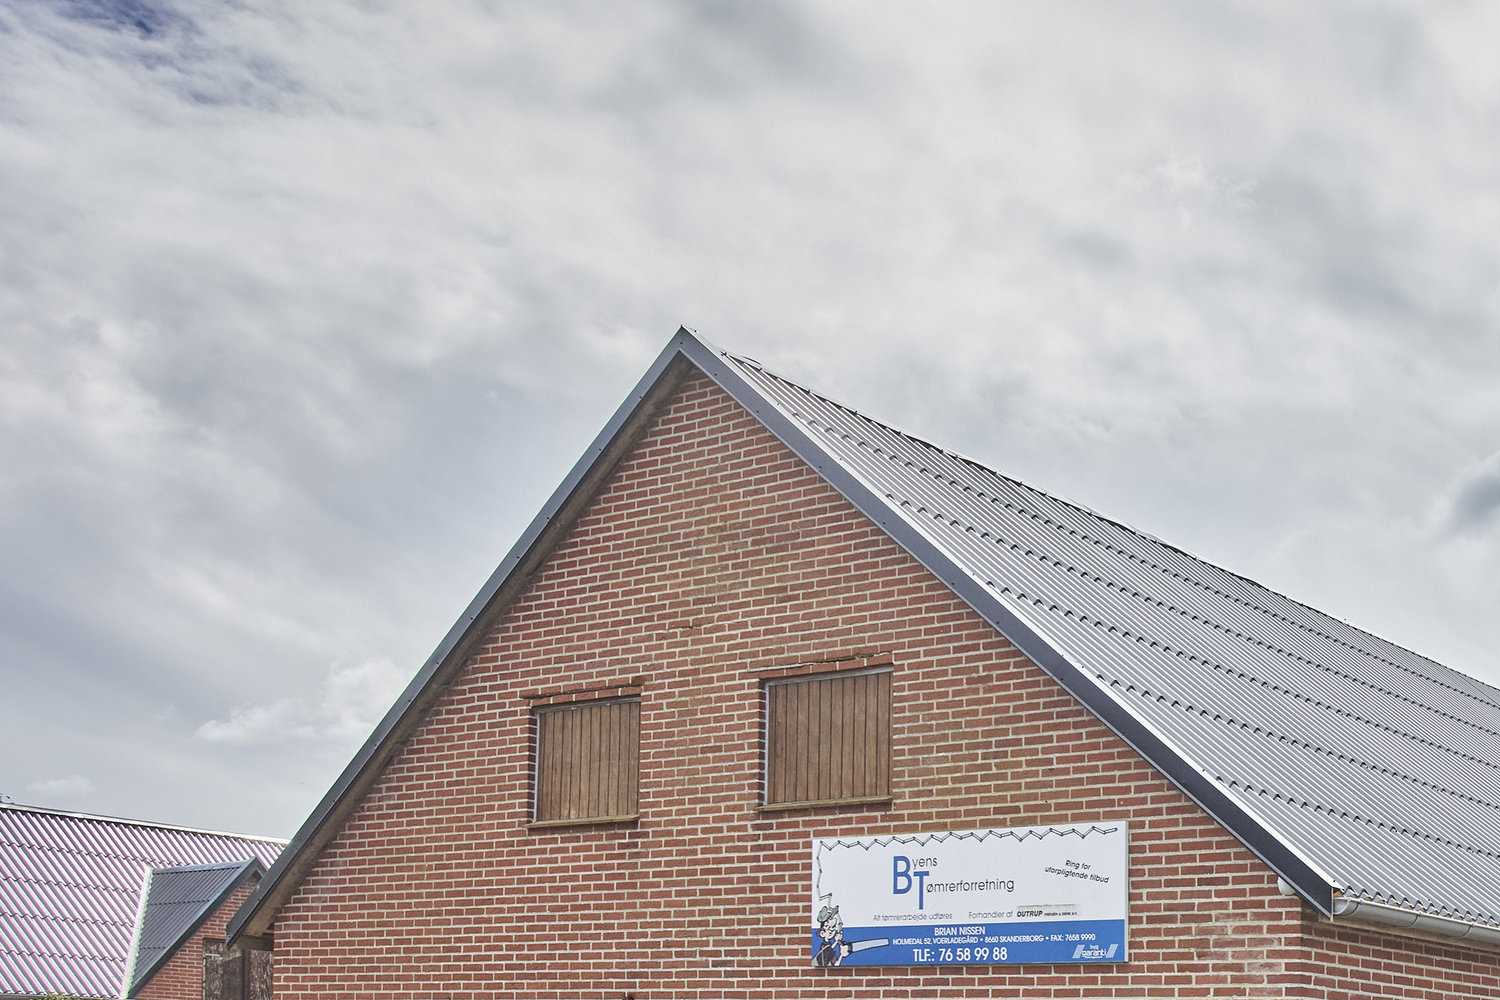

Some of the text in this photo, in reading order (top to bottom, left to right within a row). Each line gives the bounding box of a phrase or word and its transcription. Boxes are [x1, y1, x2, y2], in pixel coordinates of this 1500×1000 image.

[1065, 859, 1091, 870] Ring for
[893, 855, 938, 895] Byens
[1044, 865, 1110, 884] uforpligtende tilbud
[913, 870, 1015, 910] Tømrerforretning
[968, 910, 1004, 919] Forhandler
[1017, 910, 1043, 918] OUTRUP
[934, 926, 986, 936] BRIAN NISSEN
[933, 936, 979, 944] VOERLADEGÅRD
[984, 935, 999, 943] 8660
[1000, 934, 1044, 943] SKANDERBORG
[1050, 934, 1064, 942] FAX:
[1065, 933, 1079, 941] 7658
[1080, 933, 1096, 941] 9990
[938, 948, 953, 961] 76
[956, 947, 971, 961] 58
[974, 947, 990, 961] 99
[992, 946, 1008, 961] 88
